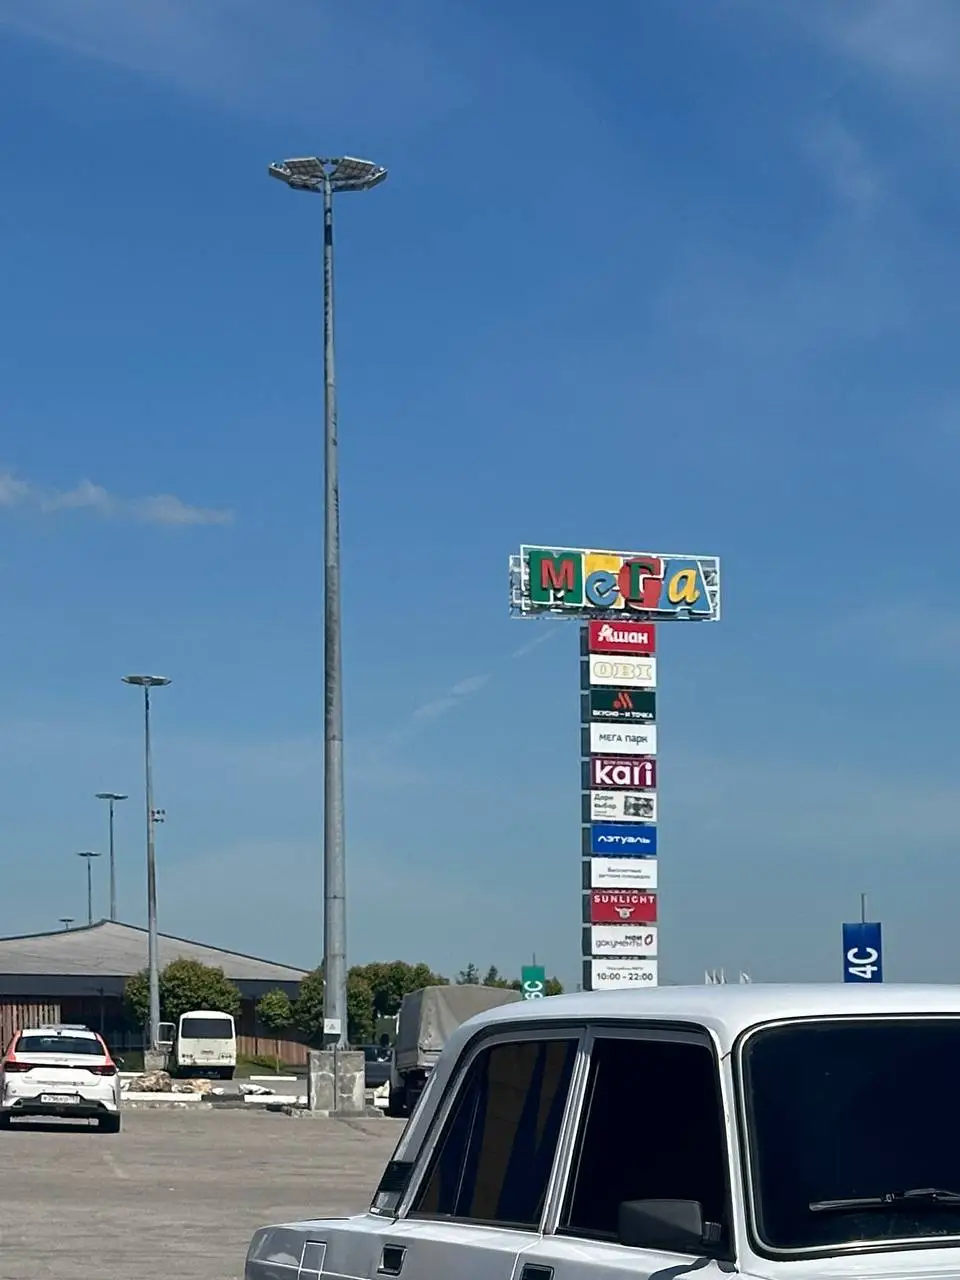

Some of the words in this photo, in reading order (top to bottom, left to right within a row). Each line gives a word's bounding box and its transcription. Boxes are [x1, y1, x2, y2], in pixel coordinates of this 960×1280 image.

[597, 624, 649, 644] Ашан
[593, 661, 652, 680] OBI
[599, 734, 623, 742] МЕГА
[625, 735, 648, 746] парк
[595, 760, 652, 786] kari
[594, 895, 655, 904] SUNLIGHT
[597, 973, 621, 981] 10:00
[628, 973, 653, 981] 22:00
